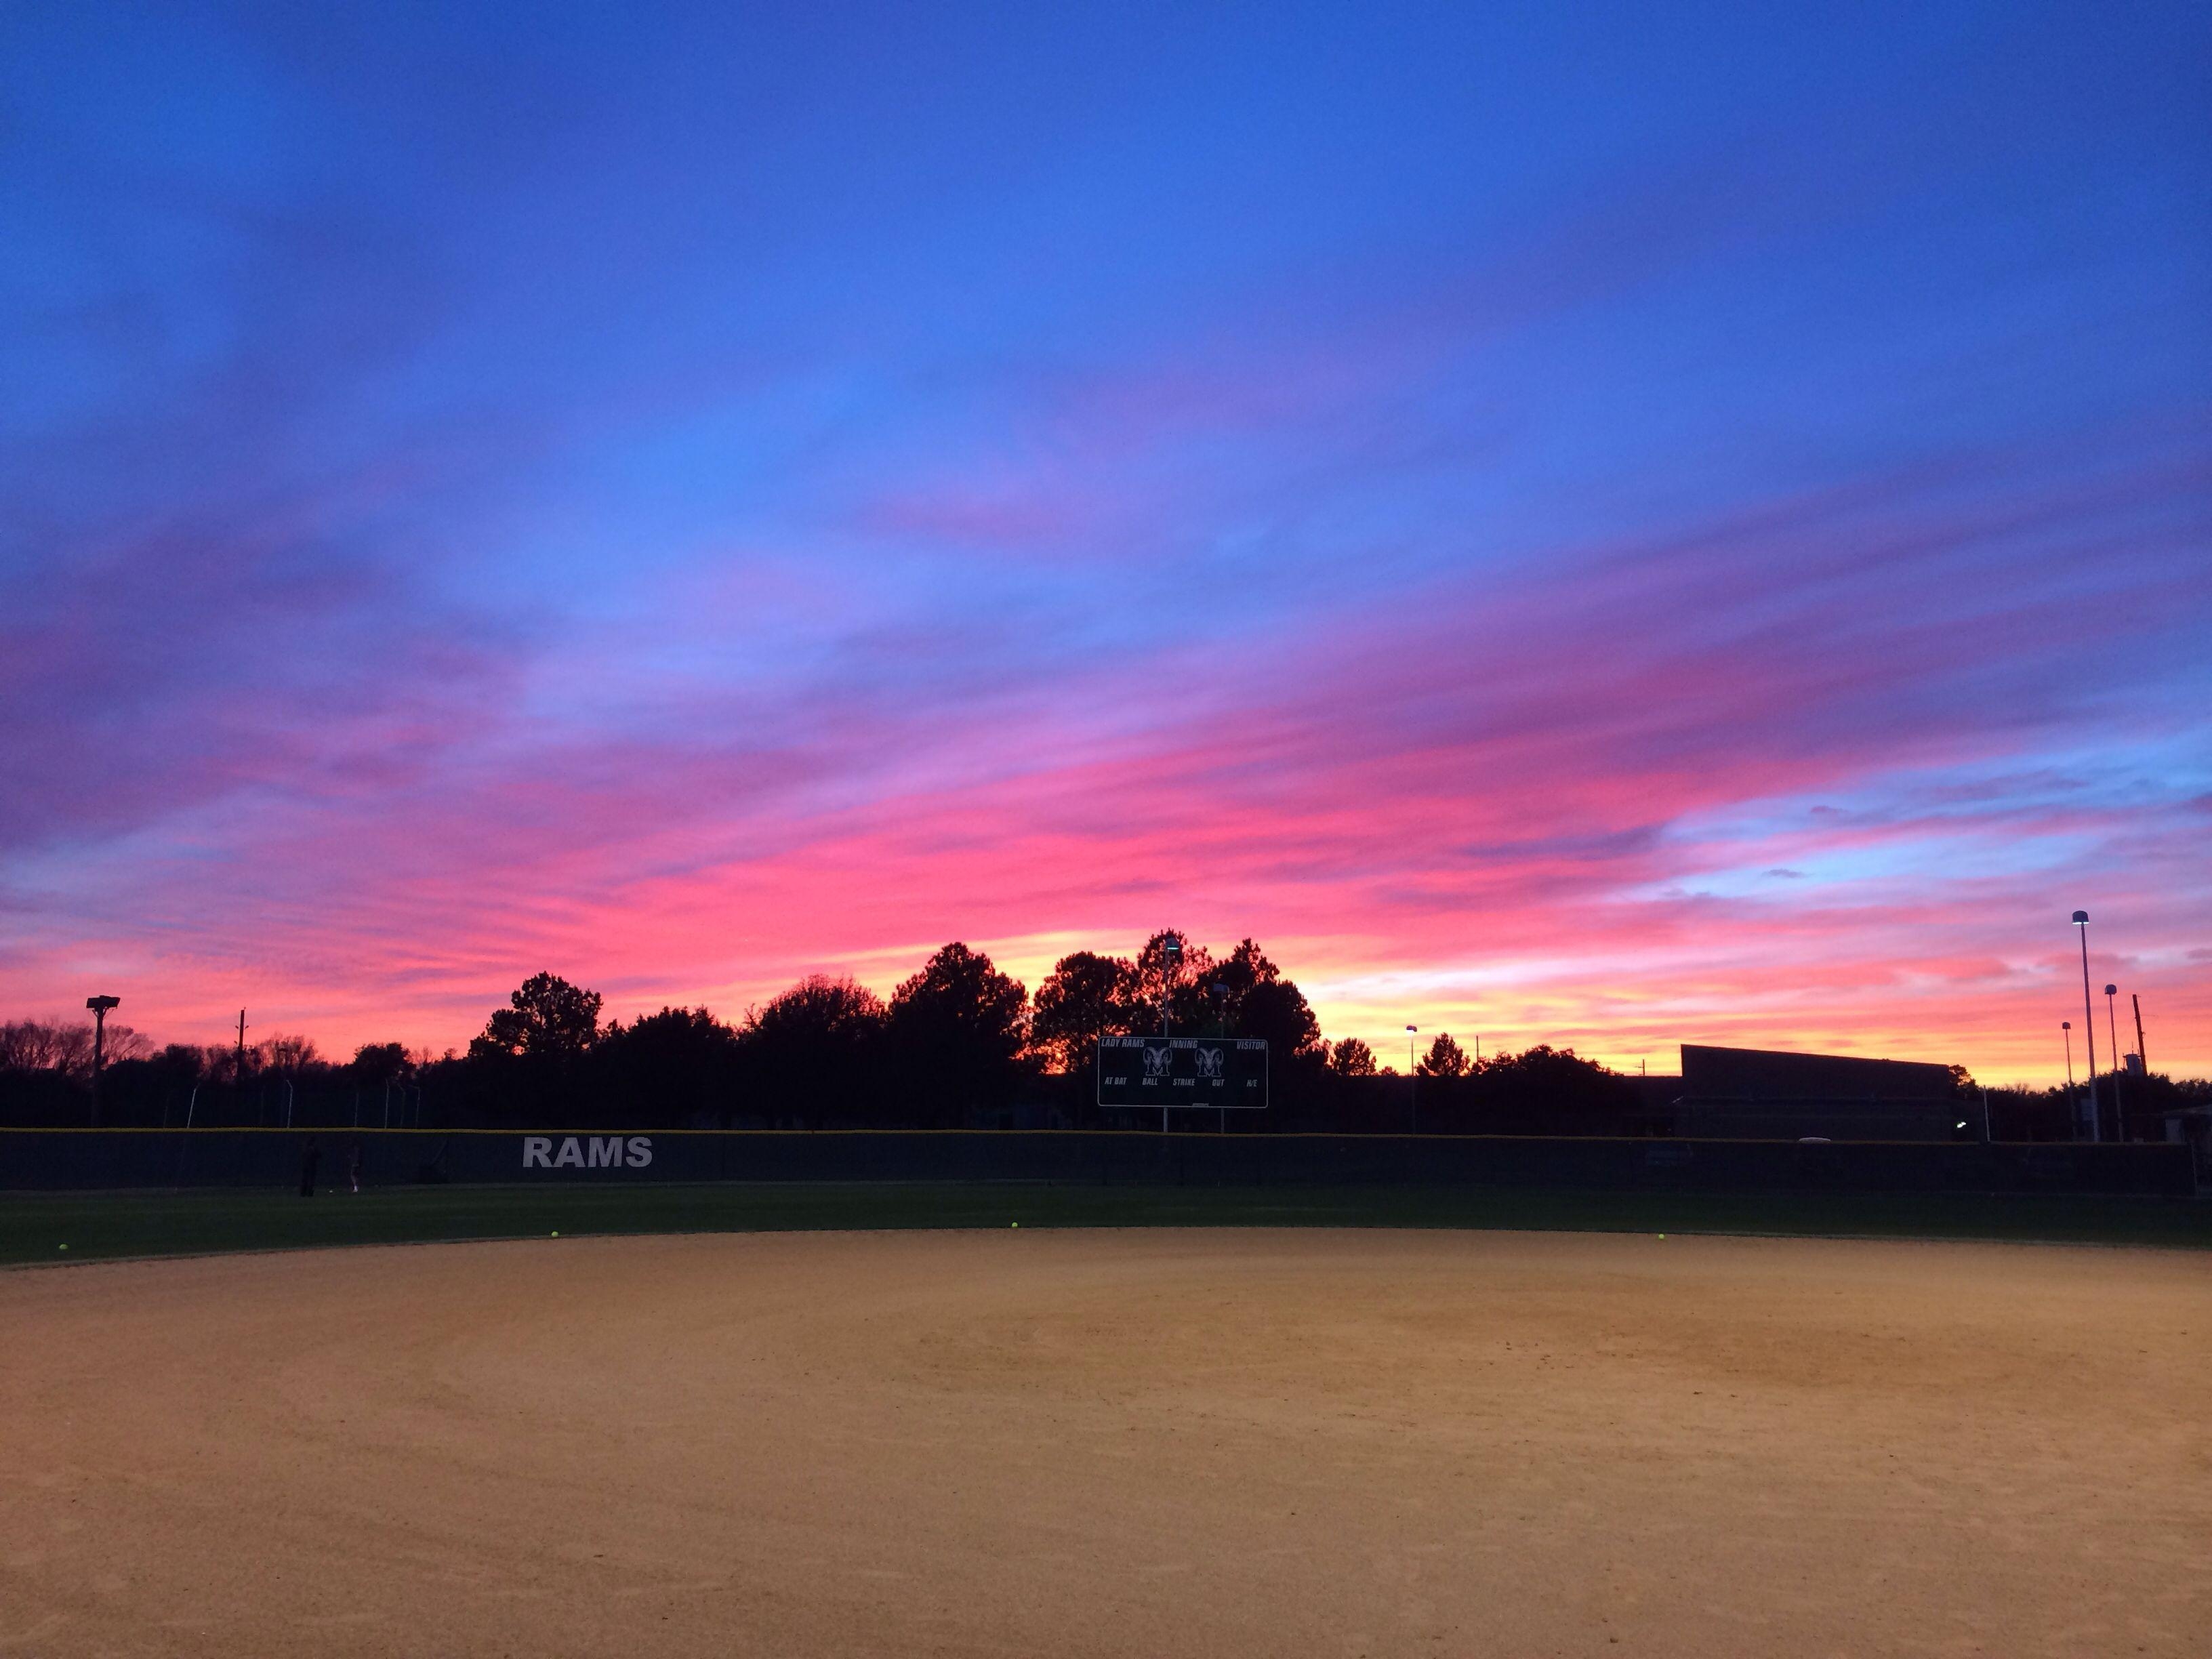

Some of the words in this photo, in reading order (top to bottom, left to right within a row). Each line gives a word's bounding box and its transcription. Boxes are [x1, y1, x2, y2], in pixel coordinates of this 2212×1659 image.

[1101, 1038, 1122, 1047] LADY
[1121, 1039, 1145, 1048] RAMS
[1169, 1040, 1198, 1048] INNING
[1236, 1040, 1266, 1050] VISITOR
[1114, 1077, 1128, 1085] BAT
[1142, 1078, 1158, 1086] BALL
[1172, 1078, 1195, 1086] STRIKE
[523, 1136, 653, 1168] RAMS
